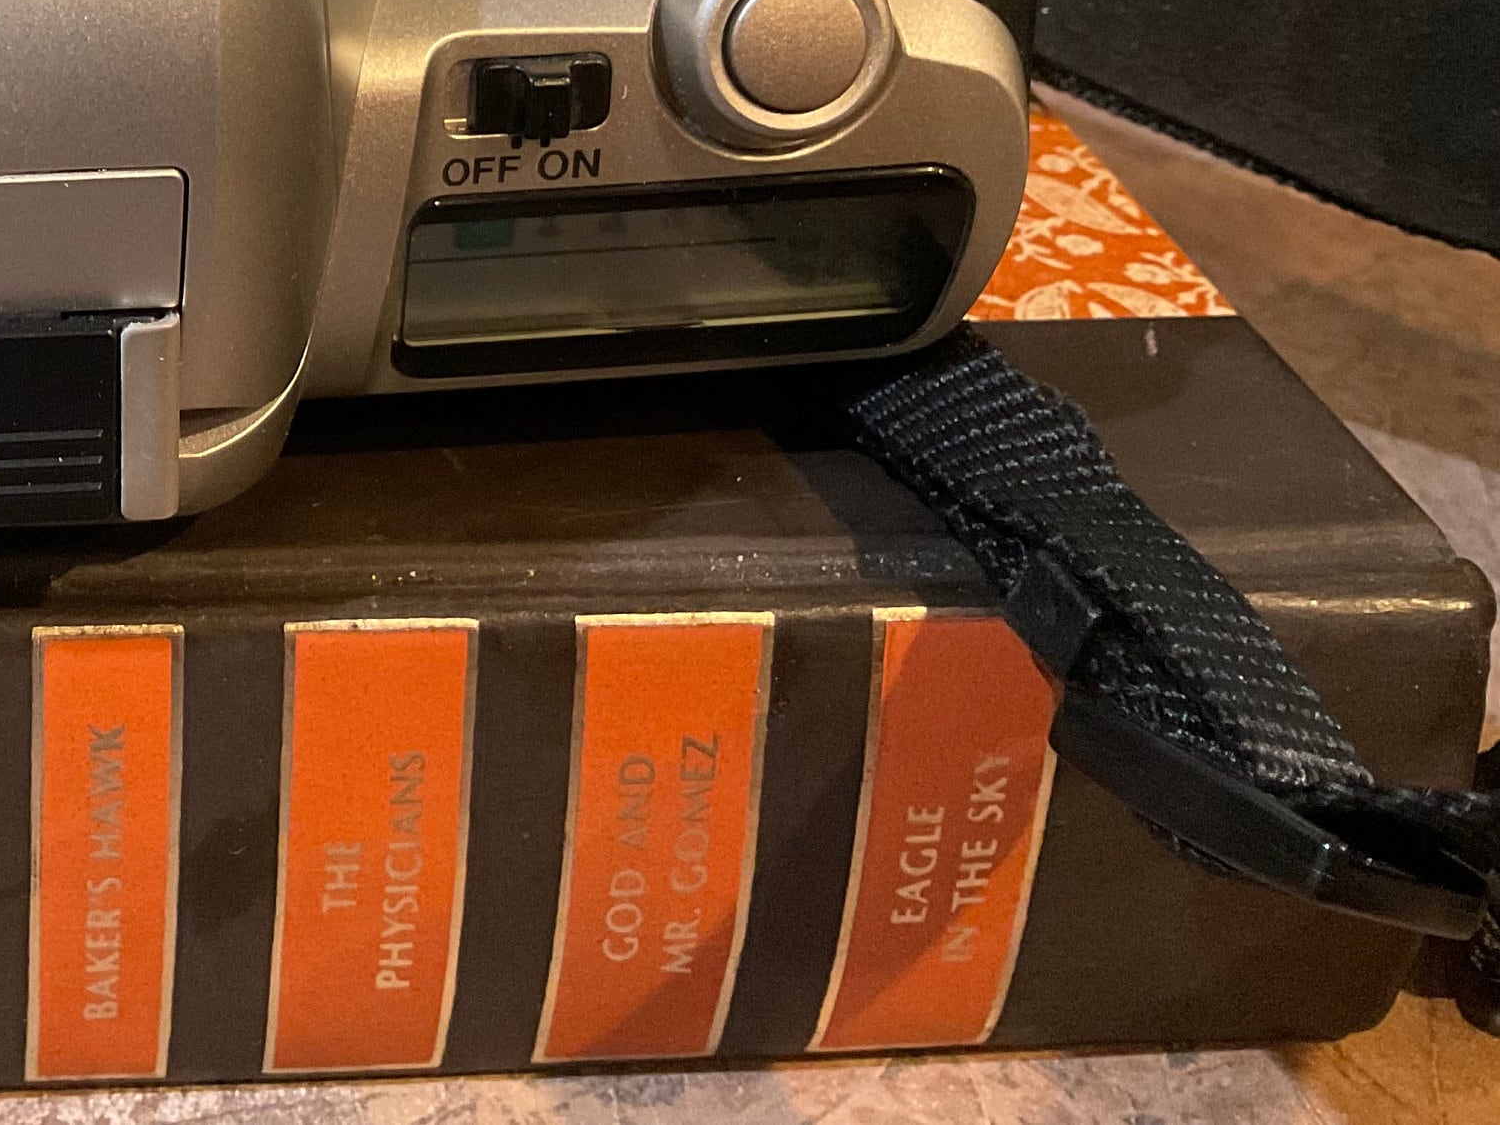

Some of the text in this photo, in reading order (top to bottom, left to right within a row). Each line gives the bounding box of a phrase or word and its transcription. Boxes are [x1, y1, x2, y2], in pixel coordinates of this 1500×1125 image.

[442, 149, 601, 186] OFF ON
[83, 723, 126, 1021] BAKER'S HAWK
[322, 840, 362, 912] THE
[374, 750, 427, 991] PHYSICIANS
[602, 753, 656, 963] GOD AND
[660, 732, 721, 974] MR. GOMEZ
[890, 805, 945, 926] EAGLE
[941, 754, 1010, 963] IN THE SKY
